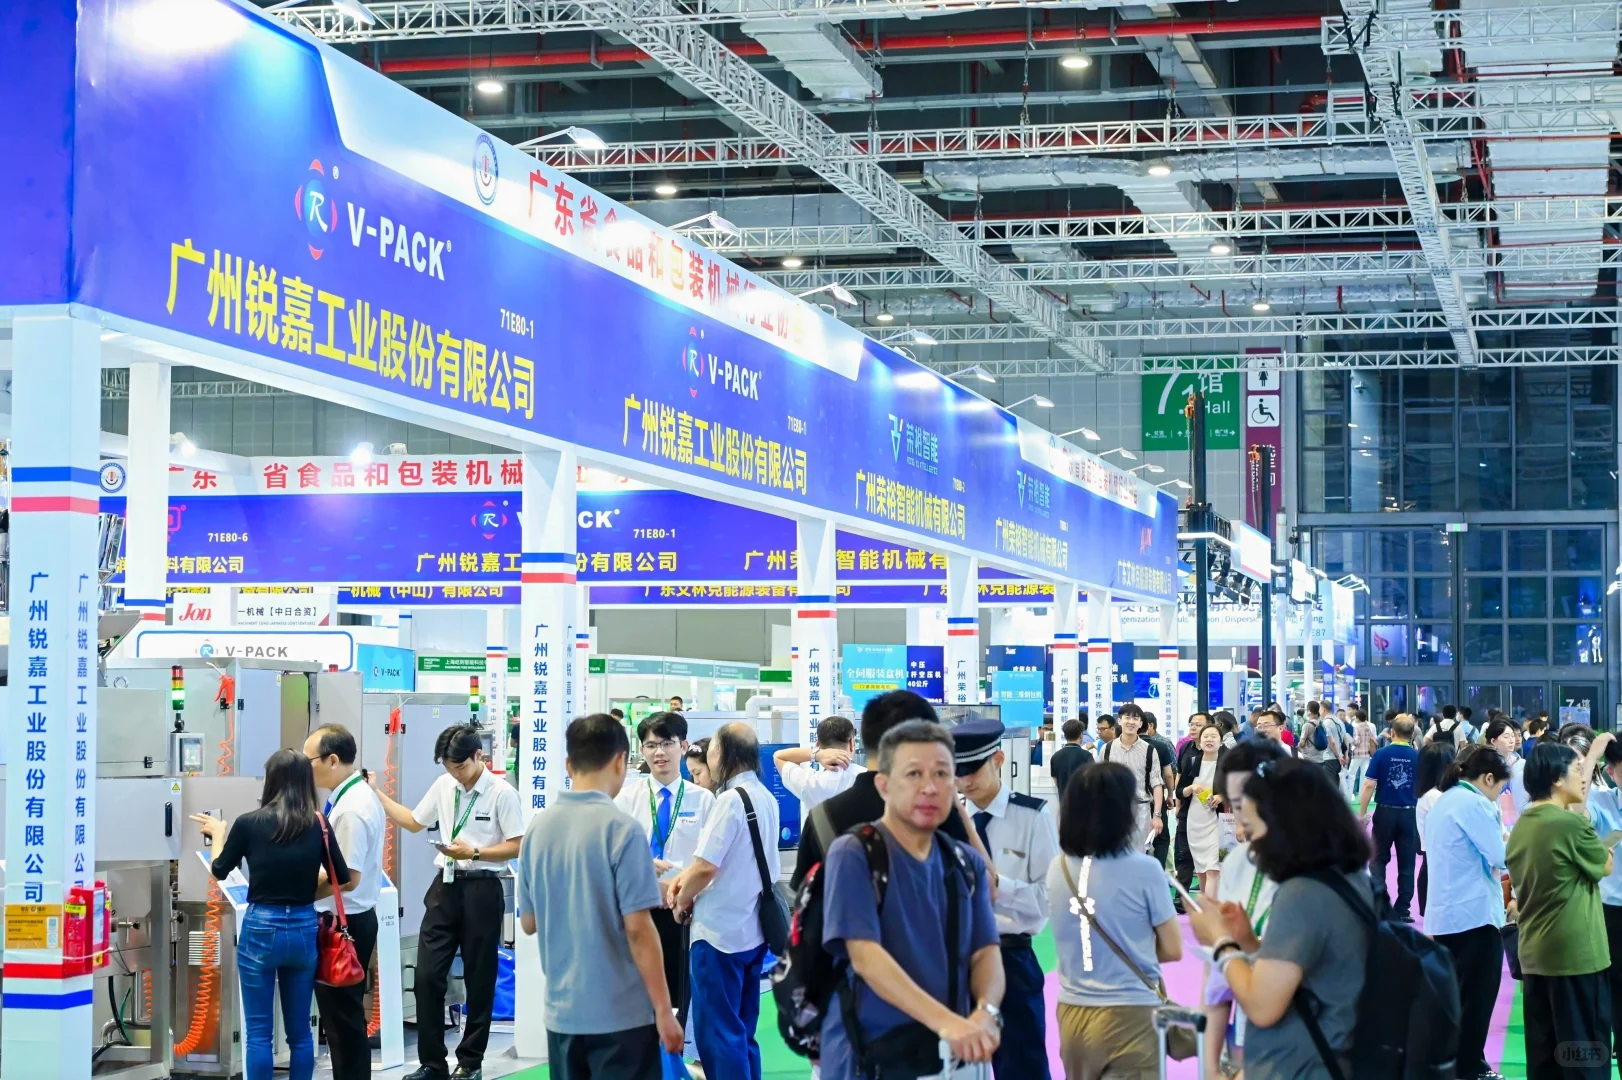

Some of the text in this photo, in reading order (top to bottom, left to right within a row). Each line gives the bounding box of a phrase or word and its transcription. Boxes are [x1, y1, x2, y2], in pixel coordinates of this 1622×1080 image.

[347, 202, 446, 281] V-PACK
[166, 237, 536, 420] 广州锐嘉工业股份有限公司
[499, 307, 535, 340] 71E80-1
[708, 352, 759, 401] V-PACK
[622, 393, 807, 495] 广州锐嘉工业股份有限公司
[855, 468, 966, 541] 广州荣裕智能机械有限公司
[207, 532, 248, 543] 71E80-6
[633, 528, 677, 540] 71E80-1
[416, 552, 678, 573] 广州锐嘉工份有限公司
[225, 646, 288, 657] V-PACK
[957, 659, 967, 703] 广州荣裕
[24, 571, 49, 904] 广州锐嘉工业股份有限公司
